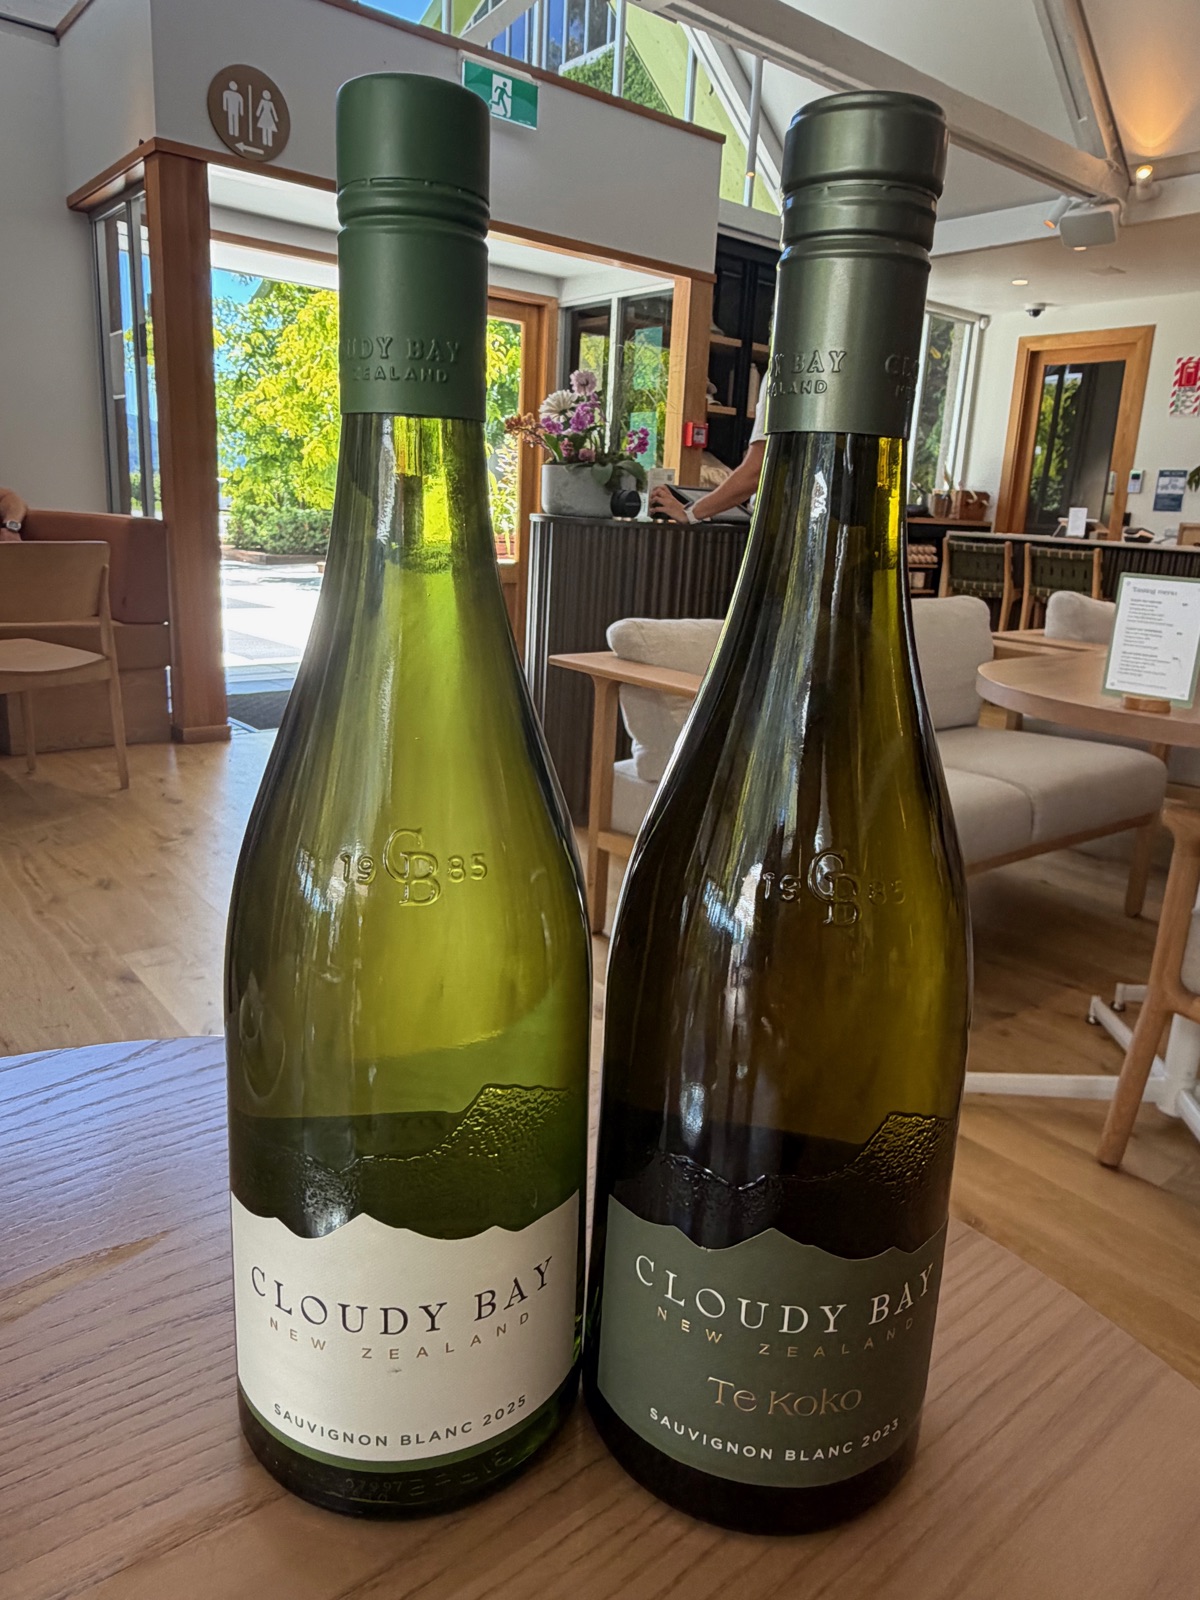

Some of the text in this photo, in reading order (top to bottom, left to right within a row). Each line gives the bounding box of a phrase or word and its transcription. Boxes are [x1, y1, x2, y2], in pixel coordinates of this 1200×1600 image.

[406, 337, 460, 363] BAY
[791, 349, 847, 374] BAY
[341, 852, 376, 885] 19
[448, 853, 487, 883] 85
[251, 1256, 553, 1335] CLOUDY BAY
[635, 1254, 934, 1334] CLOUDY BAY
[269, 1312, 530, 1360] NEW ZEALAND
[657, 1306, 914, 1358] NEW ZEALAND
[707, 1376, 758, 1412] Te
[274, 1394, 527, 1447] SAUVIGNON BLANC 2025
[650, 1407, 899, 1461] SAUVIGNON BLANC 2023
